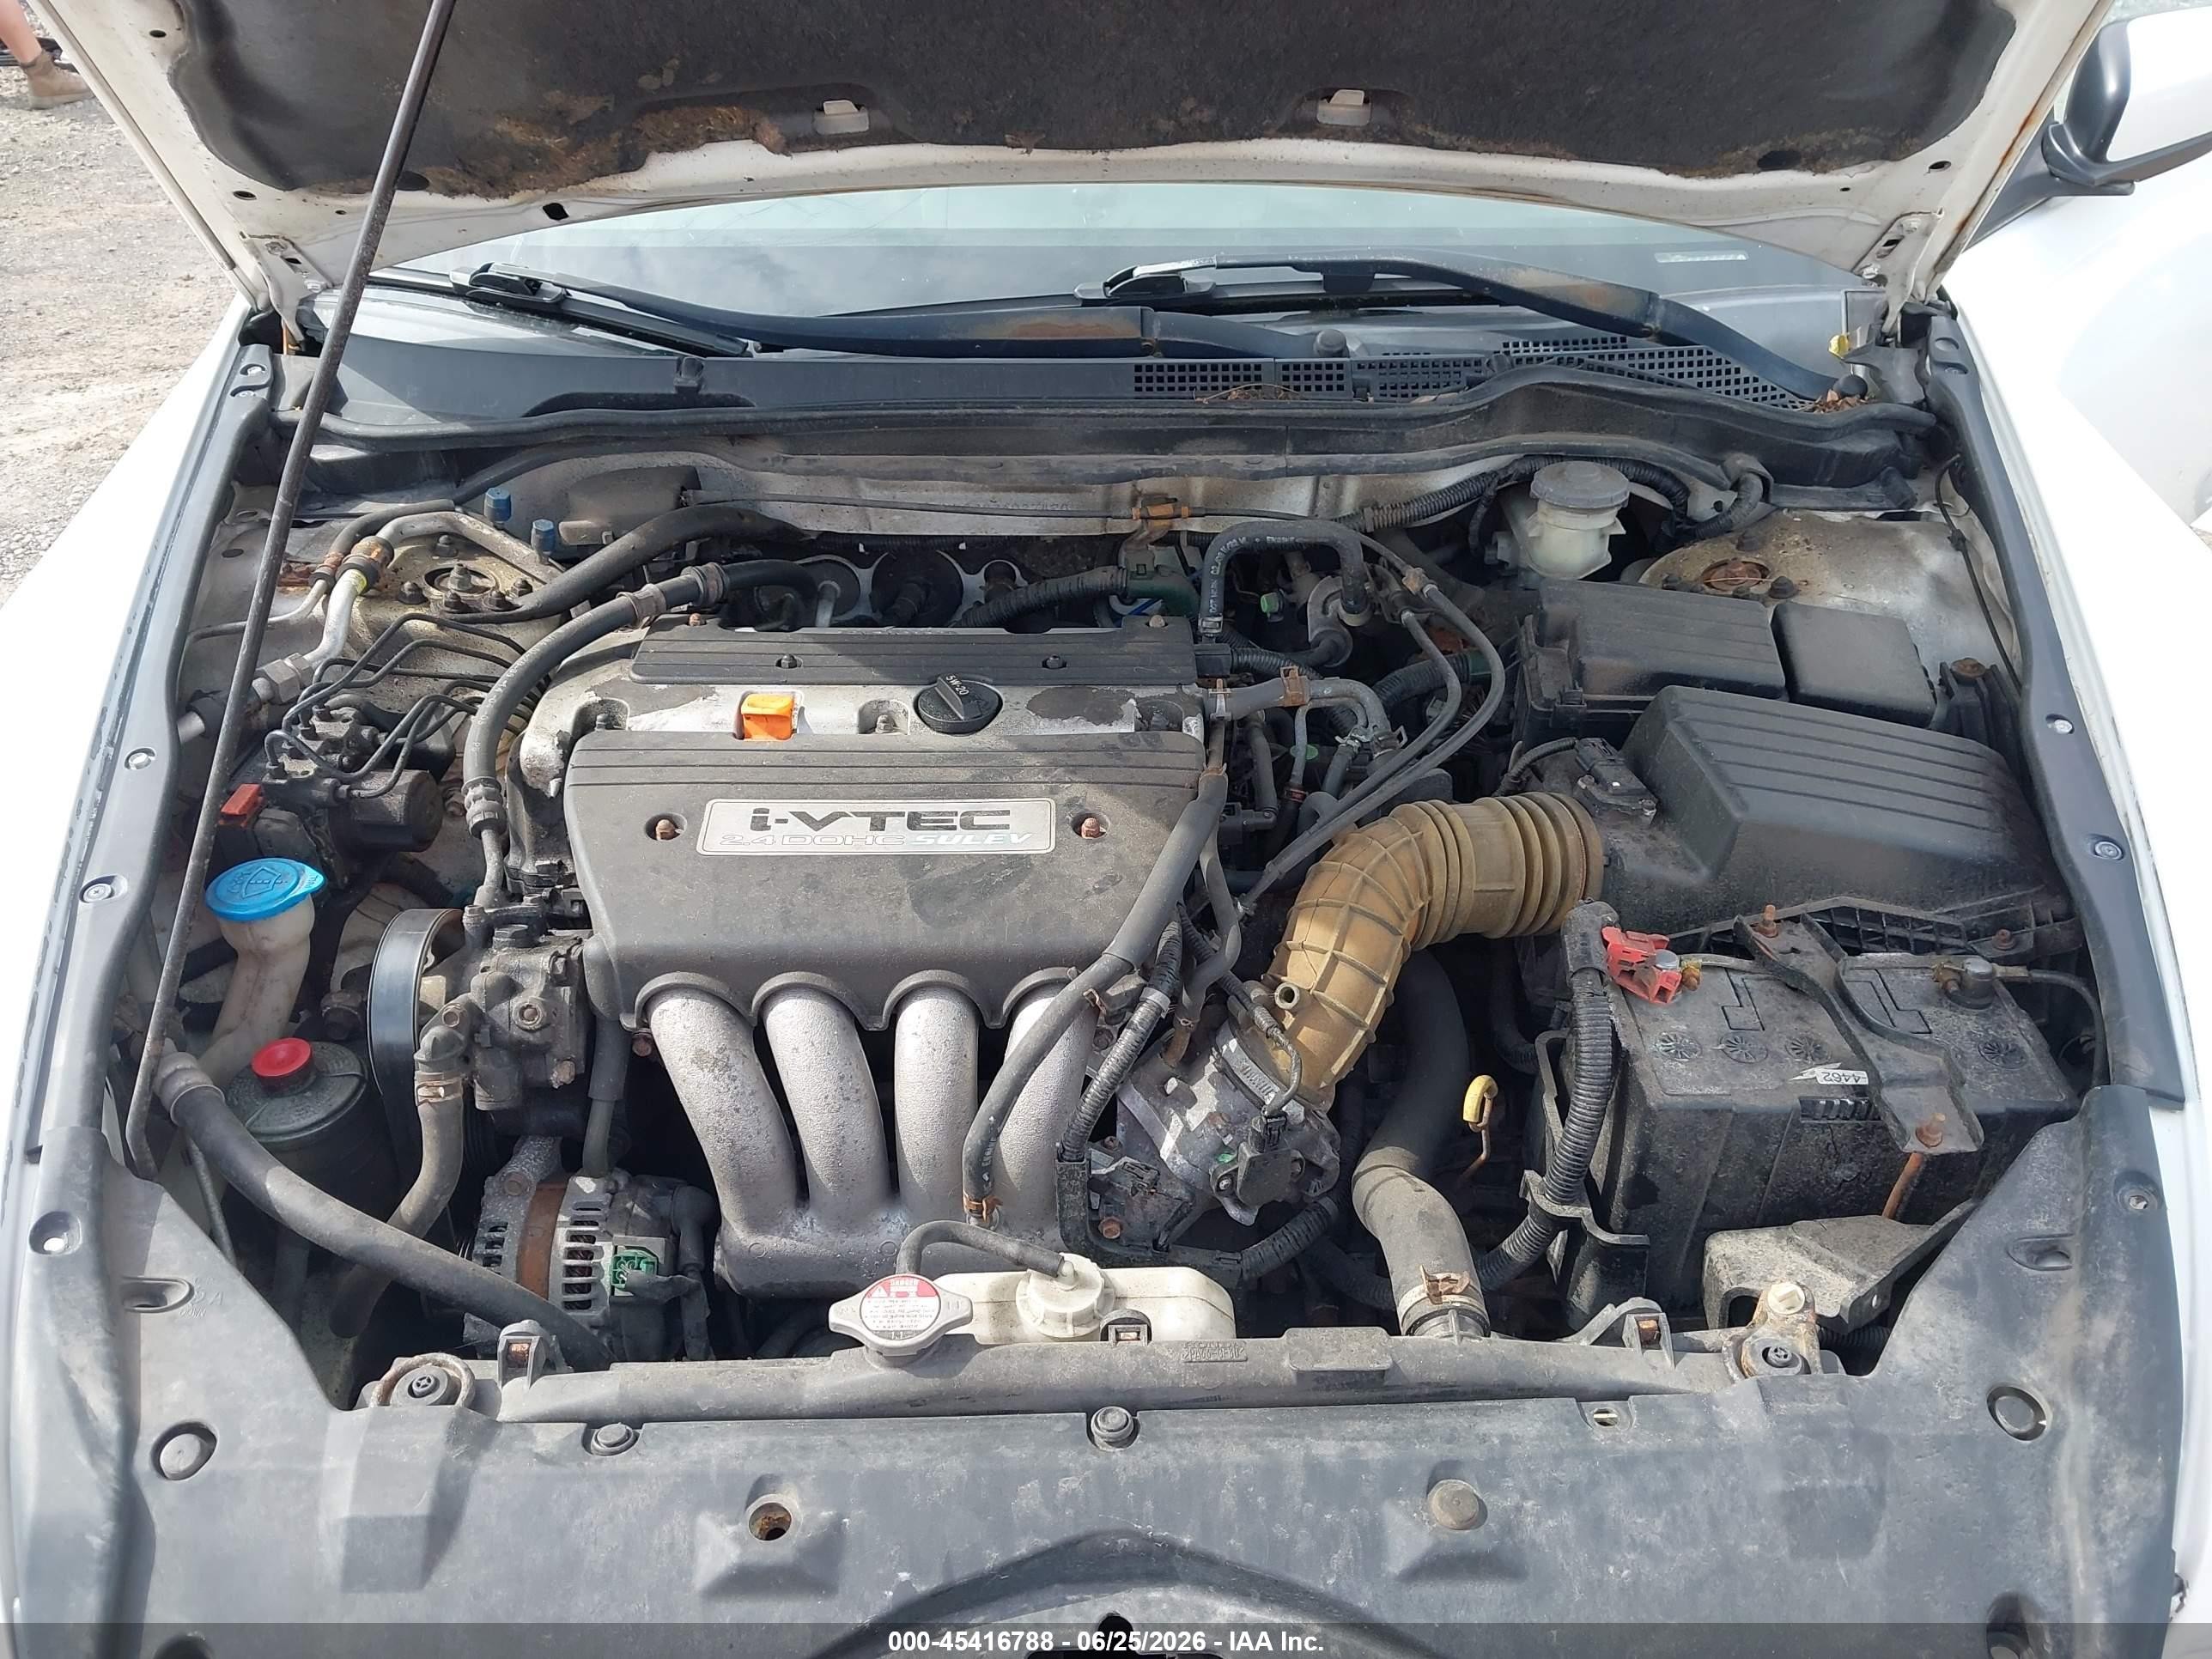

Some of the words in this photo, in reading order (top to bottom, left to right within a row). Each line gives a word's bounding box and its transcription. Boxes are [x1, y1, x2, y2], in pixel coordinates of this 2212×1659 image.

[945, 674, 969, 696] 5W-20
[750, 807, 1010, 832] i-VTEC
[720, 834, 777, 846] 2.4
[781, 834, 905, 846] DOHC
[911, 832, 1033, 846] SULEV
